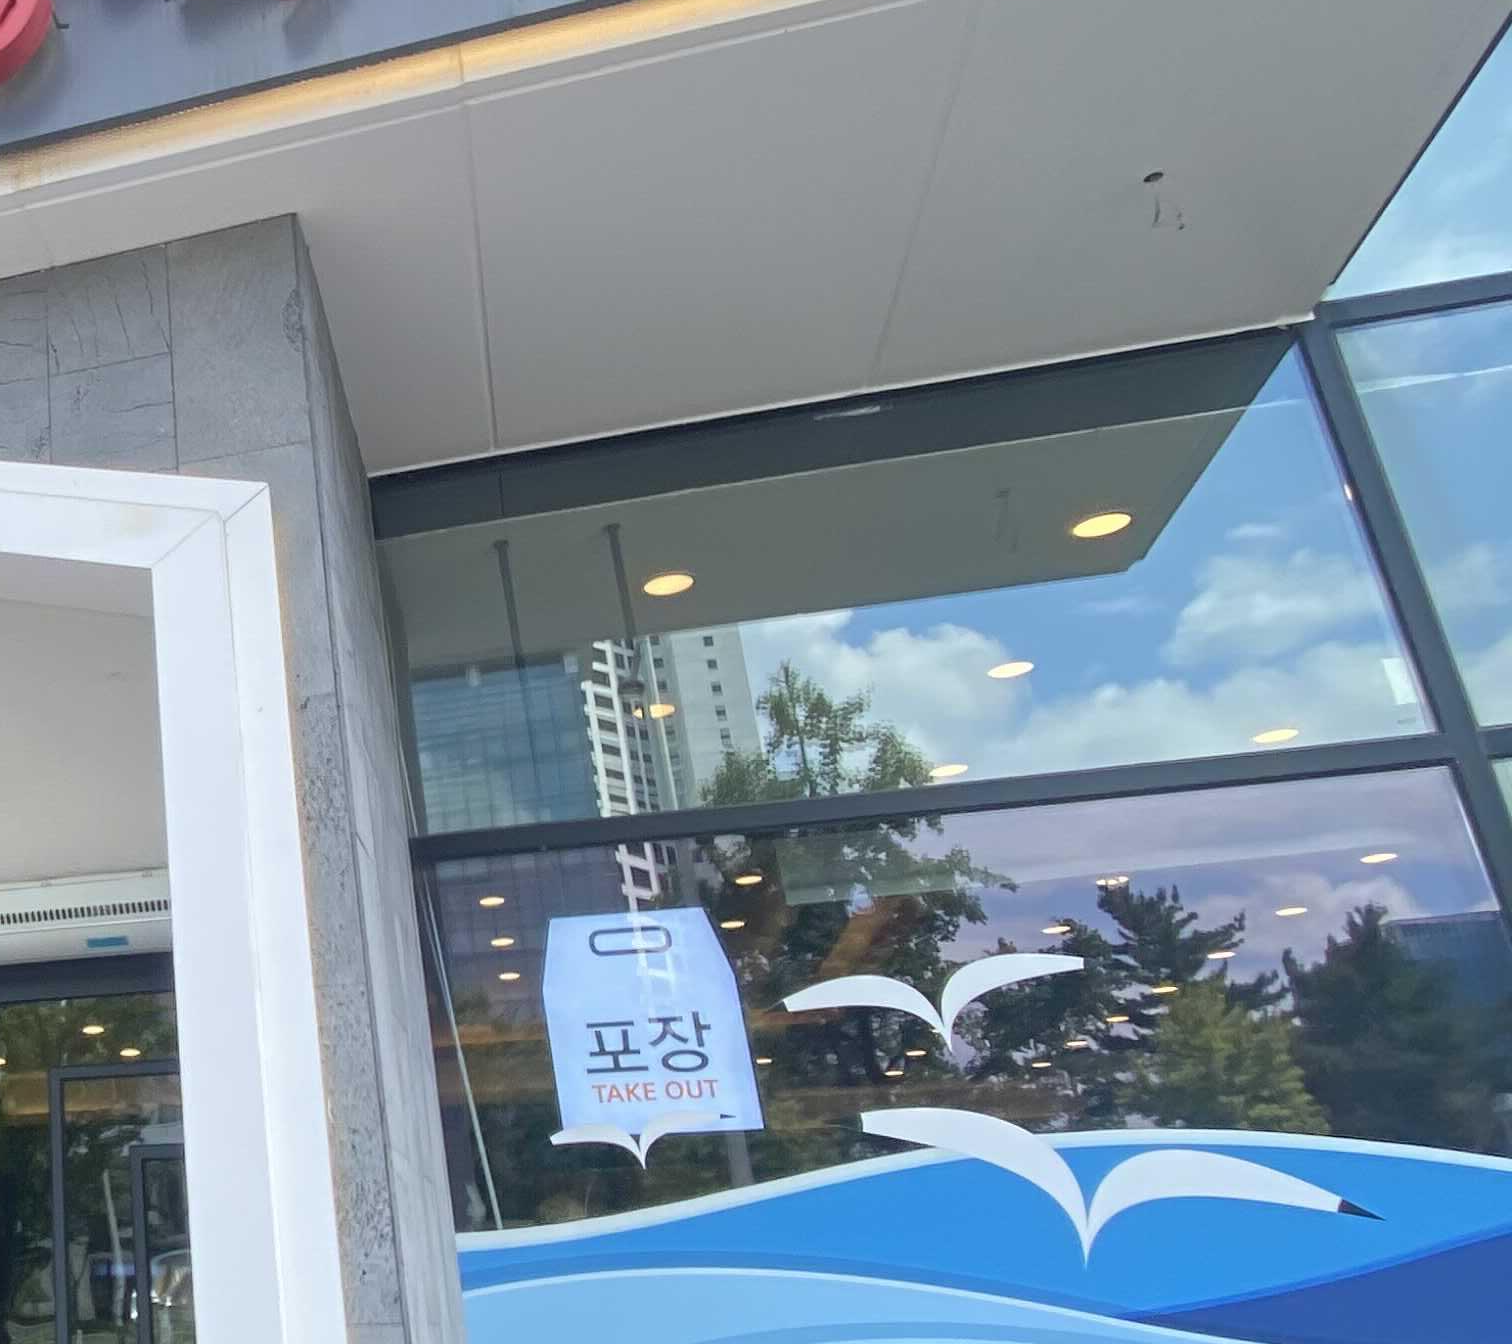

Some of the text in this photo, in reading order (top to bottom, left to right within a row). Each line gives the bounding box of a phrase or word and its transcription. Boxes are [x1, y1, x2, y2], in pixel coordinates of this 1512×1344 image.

[585, 1010, 711, 1074] 포장
[592, 1079, 719, 1104] TAKE OUT
